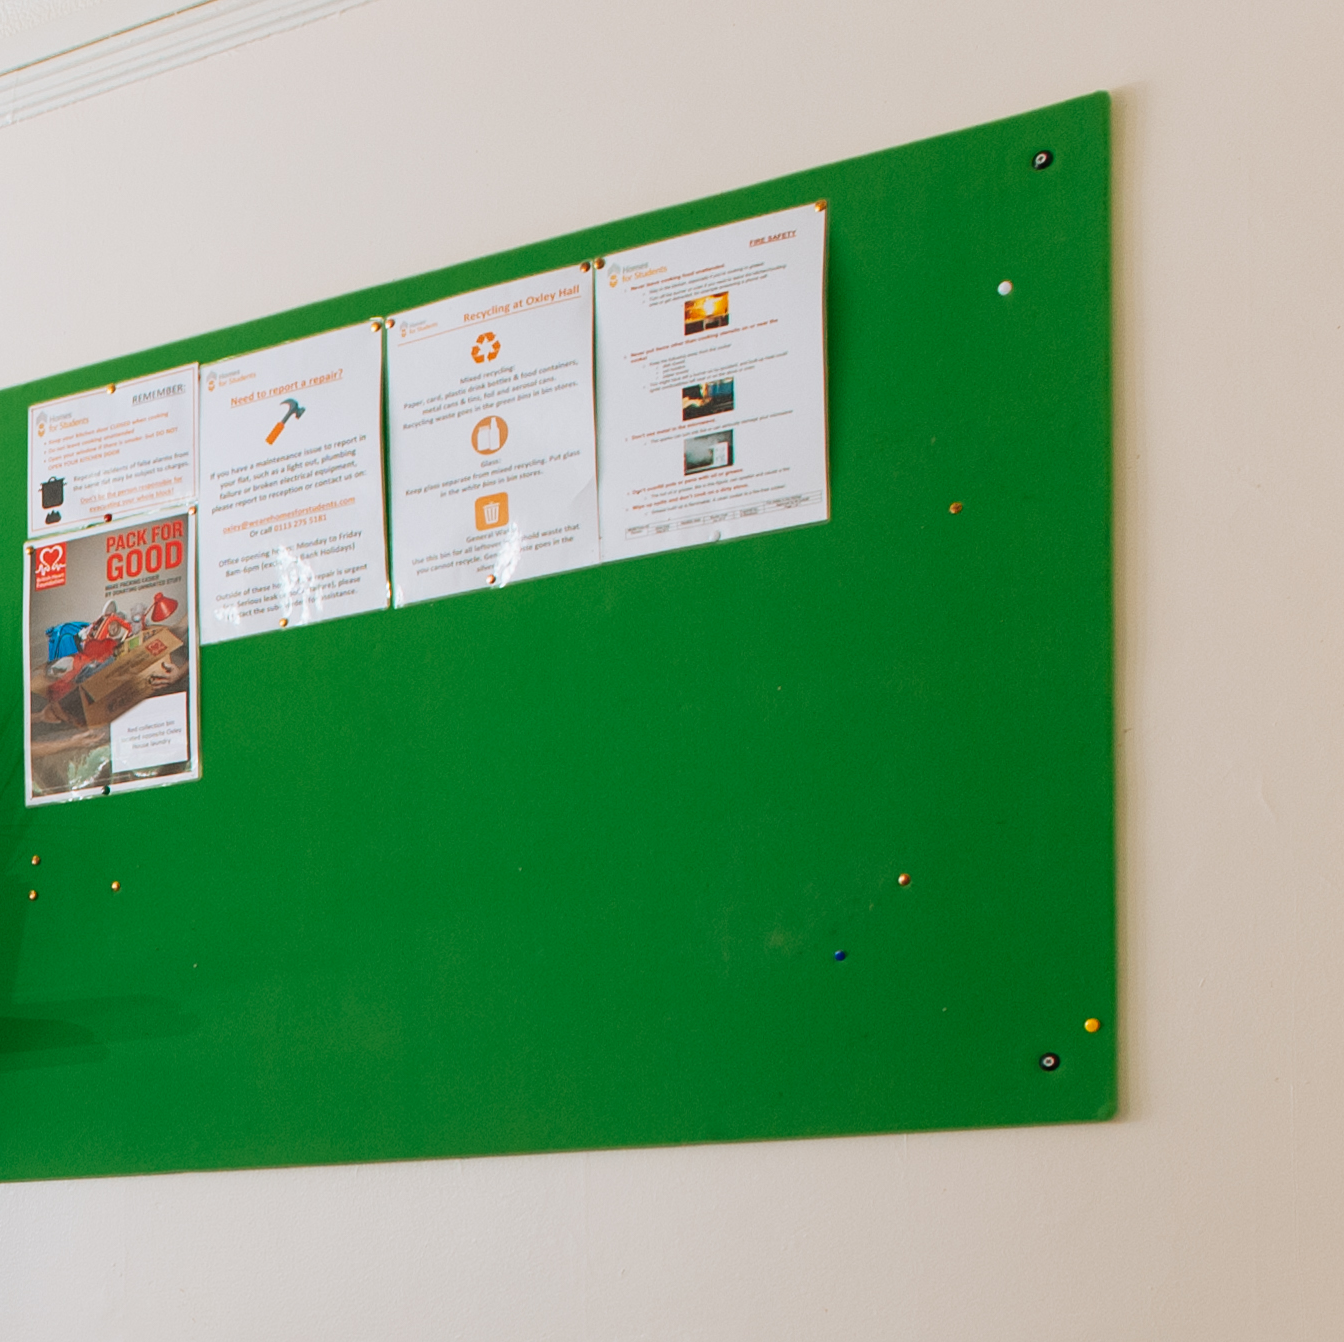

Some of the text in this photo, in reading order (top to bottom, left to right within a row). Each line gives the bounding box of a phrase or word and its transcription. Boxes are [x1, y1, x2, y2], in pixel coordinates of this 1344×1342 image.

[749, 230, 796, 247] FIRE SAFETY
[622, 266, 668, 283] for Students
[463, 284, 580, 322] Recycling at Oxley Hall
[231, 392, 254, 406] Need
[257, 391, 266, 400] to
[269, 381, 298, 396] report
[309, 369, 343, 386] repair?
[403, 400, 425, 409] Paper,
[427, 394, 443, 403] card,
[445, 389, 467, 400] plastic
[468, 383, 485, 393] drink
[487, 378, 511, 388] bottles
[520, 370, 537, 379] food
[539, 361, 579, 375] containers,
[460, 366, 516, 384] Mixed recycling:
[132, 384, 186, 405] REMEMBER:
[422, 404, 442, 415] metal
[444, 402, 459, 410] cans
[467, 396, 482, 404] tins,
[484, 391, 495, 399] foil
[497, 387, 510, 396] and
[512, 380, 537, 392] aerosol
[539, 377, 557, 385] cans.
[49, 416, 89, 433] for Students
[217, 471, 229, 480] you
[231, 466, 248, 474] have
[256, 453, 302, 468] maintenance
[304, 447, 322, 456] issue
[334, 437, 357, 448] report
[220, 480, 236, 490] your
[237, 475, 251, 484] flat,
[253, 470, 269, 480] such
[287, 462, 304, 472] light
[305, 458, 320, 467] out,
[321, 450, 356, 465] plumbing
[481, 459, 502, 468] Glass:
[212, 504, 233, 514] please
[235, 496, 257, 507] report
[269, 486, 303, 499] reception
[315, 475, 342, 488] contact
[220, 490, 242, 500] failure
[253, 481, 278, 492] broken
[280, 471, 314, 485] electrical
[315, 461, 357, 477] equipment,
[106, 520, 184, 553] PACK FOR
[250, 514, 327, 538] Or call 0113 275 5181
[106, 540, 183, 582] GOOD
[219, 559, 239, 568] Office
[241, 552, 270, 564] opening
[296, 539, 327, 550] Monday
[339, 531, 362, 541] Friday
[226, 542, 356, 578] 8am-6pm Bank Holidays)
[216, 591, 242, 602] Outside
[243, 588, 251, 596] of
[252, 586, 270, 594] these
[315, 571, 336, 580] repair
[344, 563, 367, 574] urgent
